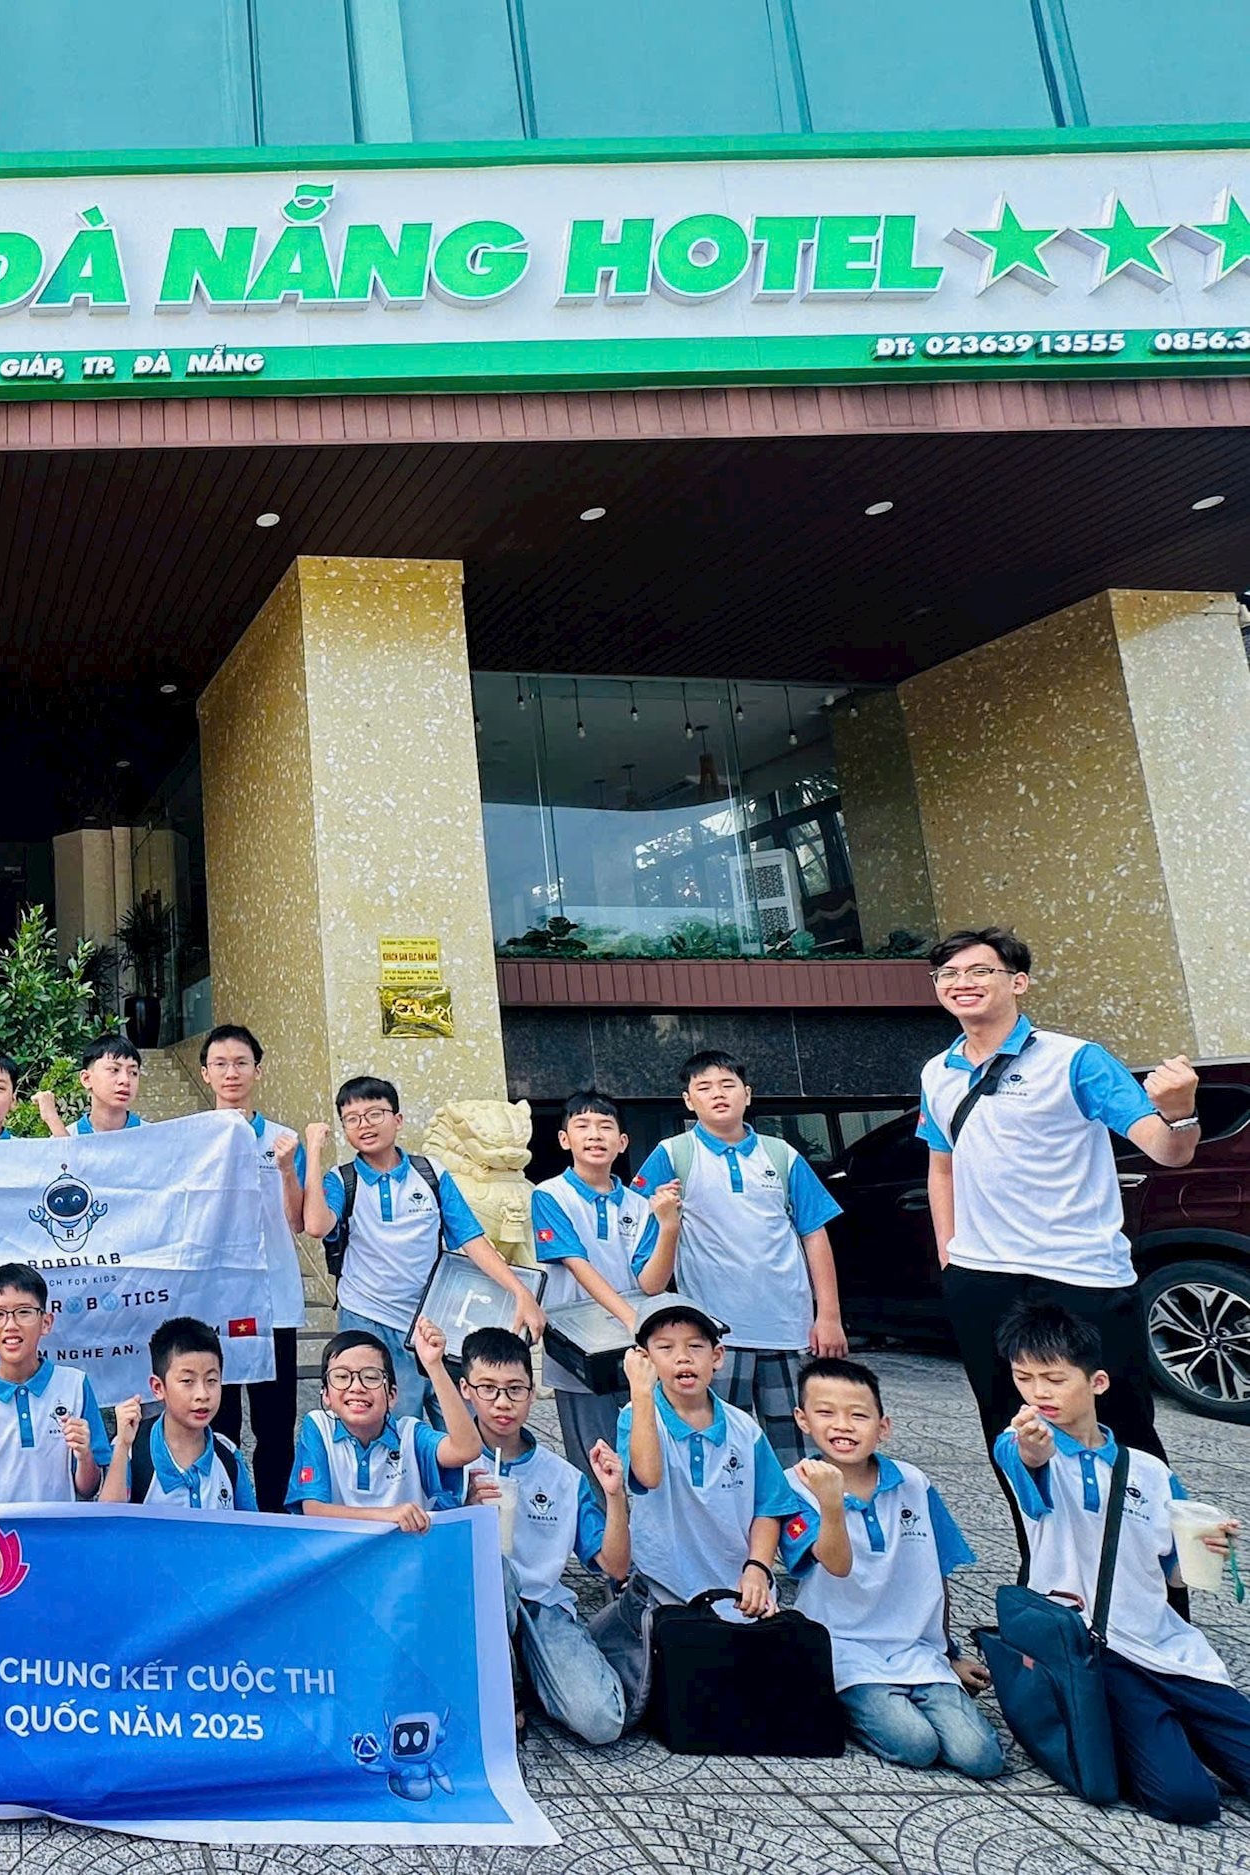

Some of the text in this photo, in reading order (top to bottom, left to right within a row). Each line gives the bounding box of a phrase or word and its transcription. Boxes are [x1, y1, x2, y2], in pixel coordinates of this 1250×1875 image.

[156, 181, 529, 309] NẴNG
[558, 211, 945, 304] HOTEL
[875, 337, 916, 358] ĐT:
[0, 353, 65, 380] GIÁP,
[82, 356, 116, 377] TP.
[133, 349, 171, 377] ĐÀ
[186, 345, 265, 375] NẴNG
[28, 1252, 122, 1270] ROBOLAB
[48, 1274, 118, 1287] CH FOR KIDS
[57, 1347, 104, 1361] NGHE
[120, 1658, 179, 1693] KẾT
[186, 1659, 277, 1700] CUỘC
[284, 1667, 336, 1696] THI
[5, 1701, 100, 1739] QUỐC
[109, 1705, 184, 1740] NĂM
[190, 1711, 265, 1742] 2025
